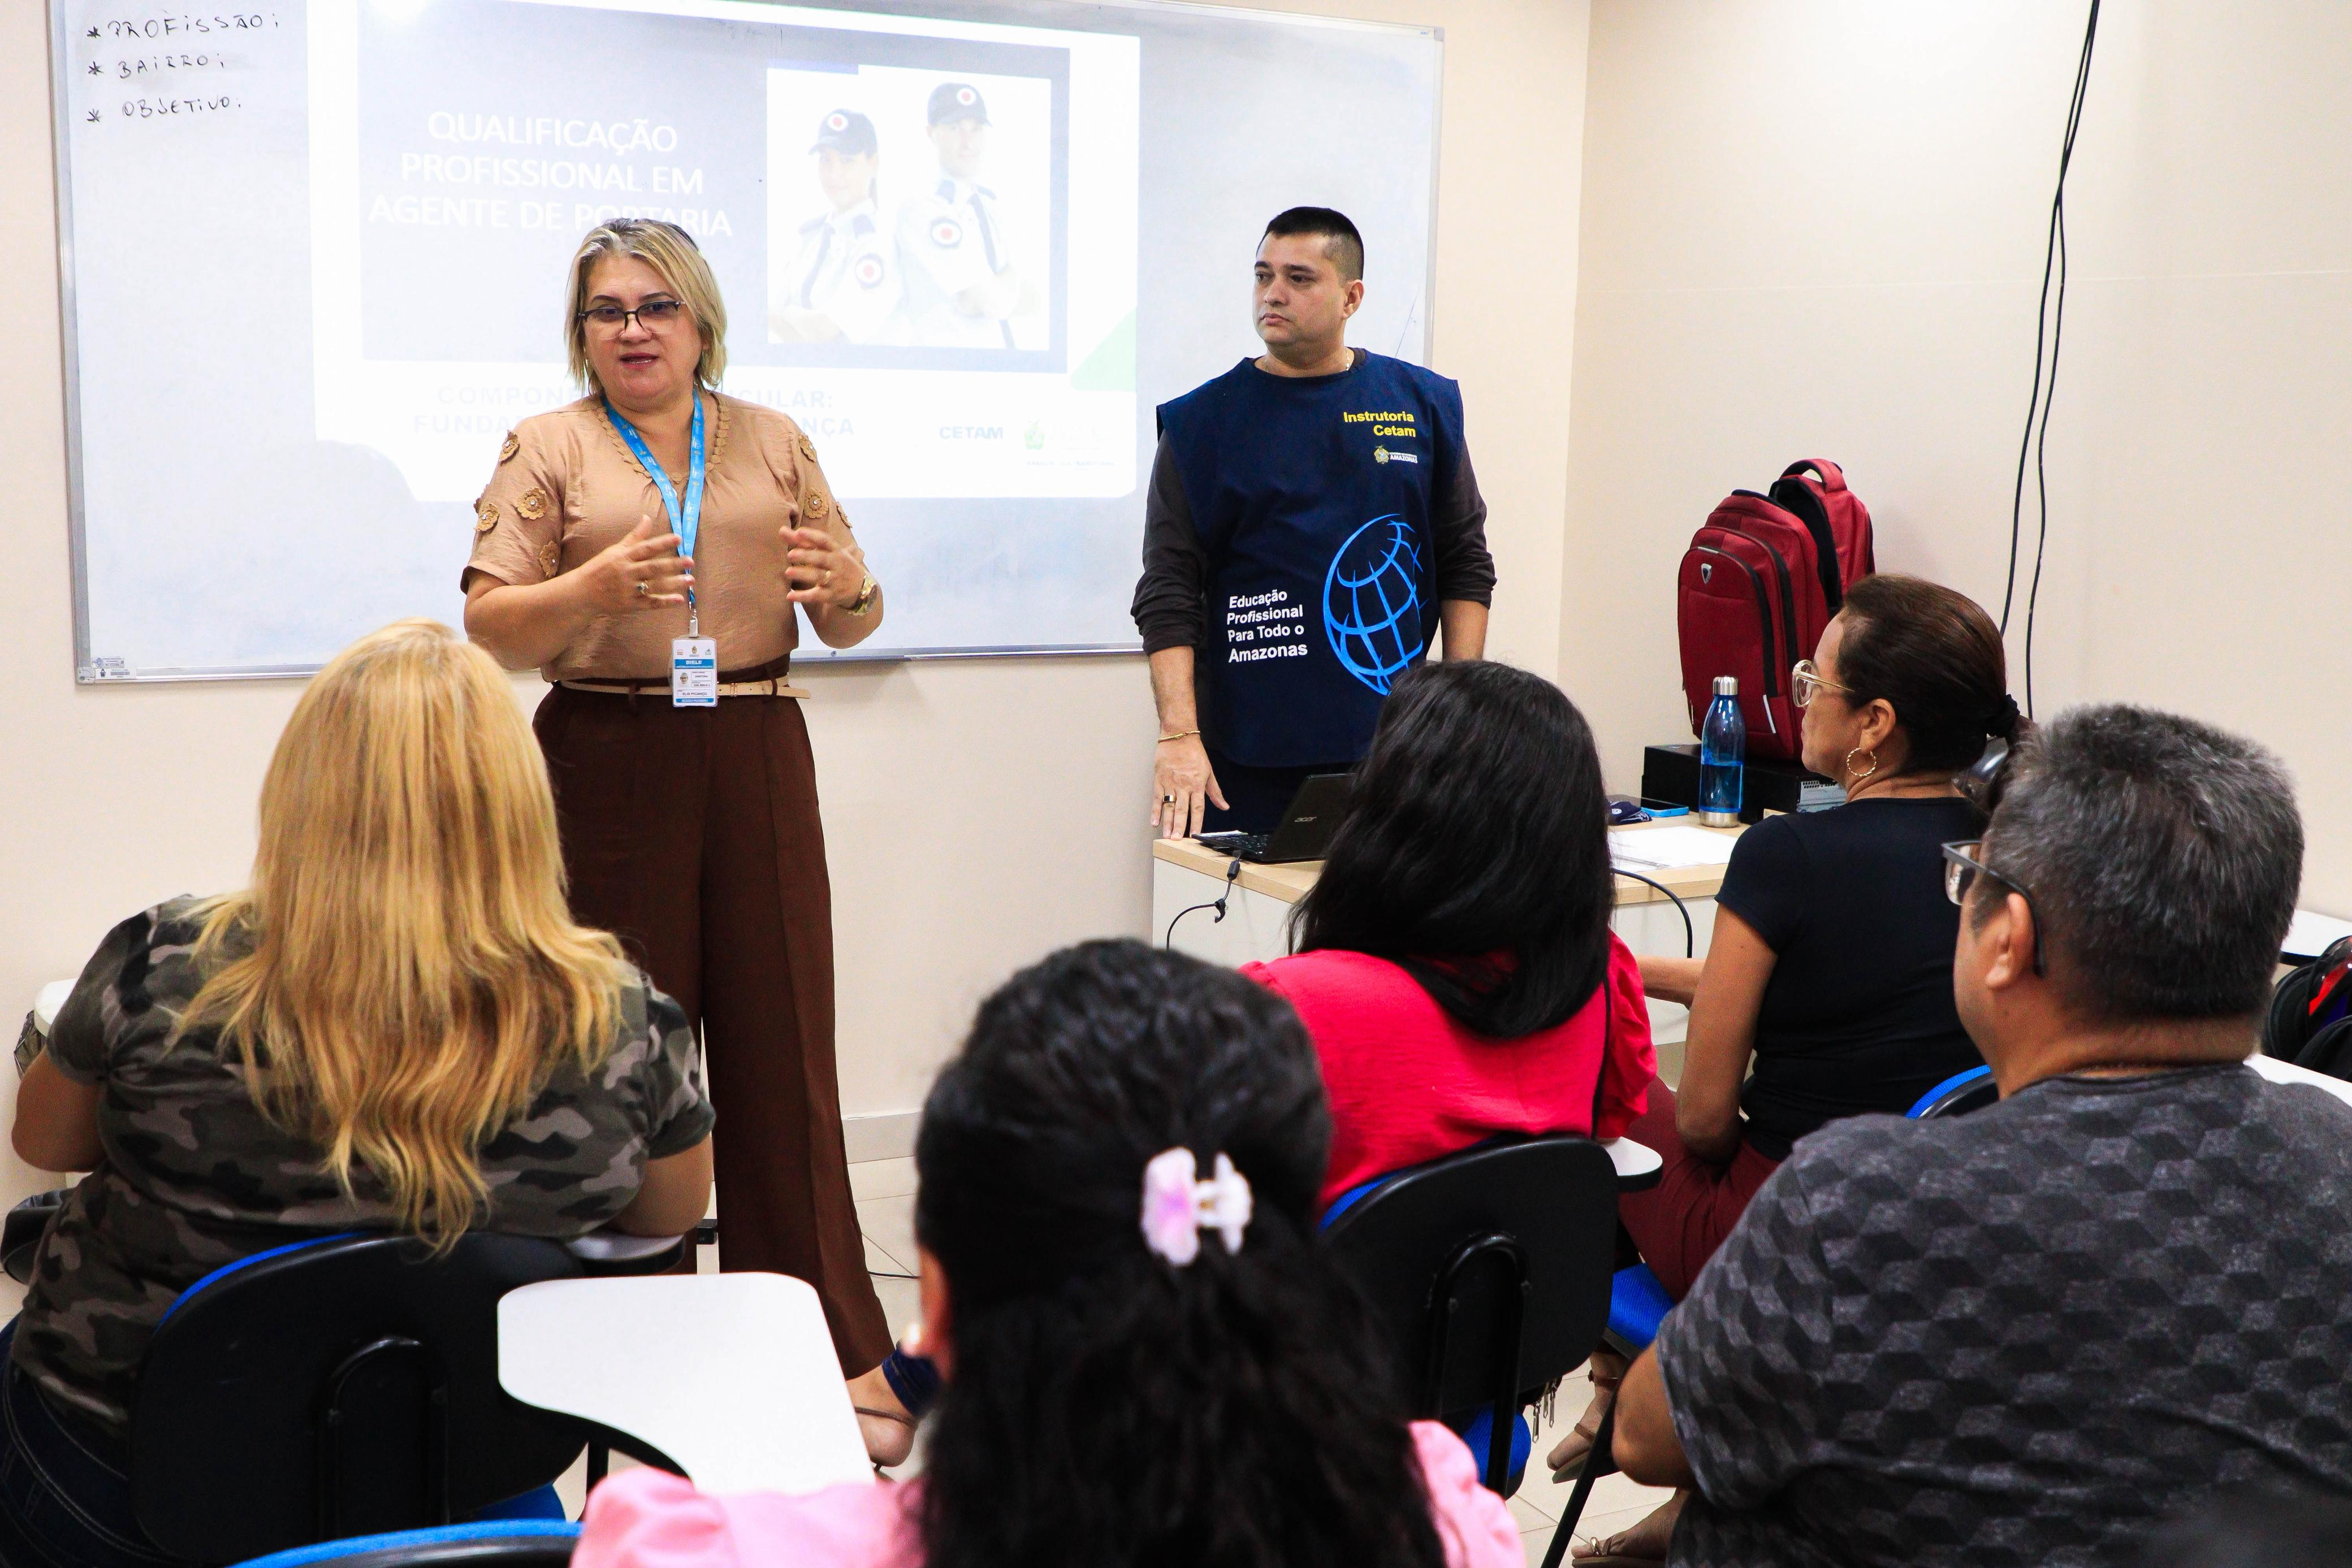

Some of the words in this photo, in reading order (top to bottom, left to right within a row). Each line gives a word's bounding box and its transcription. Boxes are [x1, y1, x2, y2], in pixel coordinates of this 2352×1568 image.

[427, 111, 677, 155] QUALIFICAÇÃO
[401, 153, 643, 192] PROFISSIONAL
[652, 166, 703, 194] EM
[368, 194, 507, 226] AGENTE
[520, 200, 563, 231] DE
[1343, 411, 1415, 423] Instrutoria
[939, 426, 1004, 440] CETAM
[1373, 425, 1416, 438] Cetam
[1390, 454, 1418, 464] AMAZONAS
[1229, 589, 1288, 609] Educação
[1226, 604, 1304, 625] Profissional
[1227, 629, 1255, 643] Para
[1256, 623, 1291, 639] Todo
[1294, 625, 1305, 635] o
[1228, 644, 1308, 663] Amazonas
